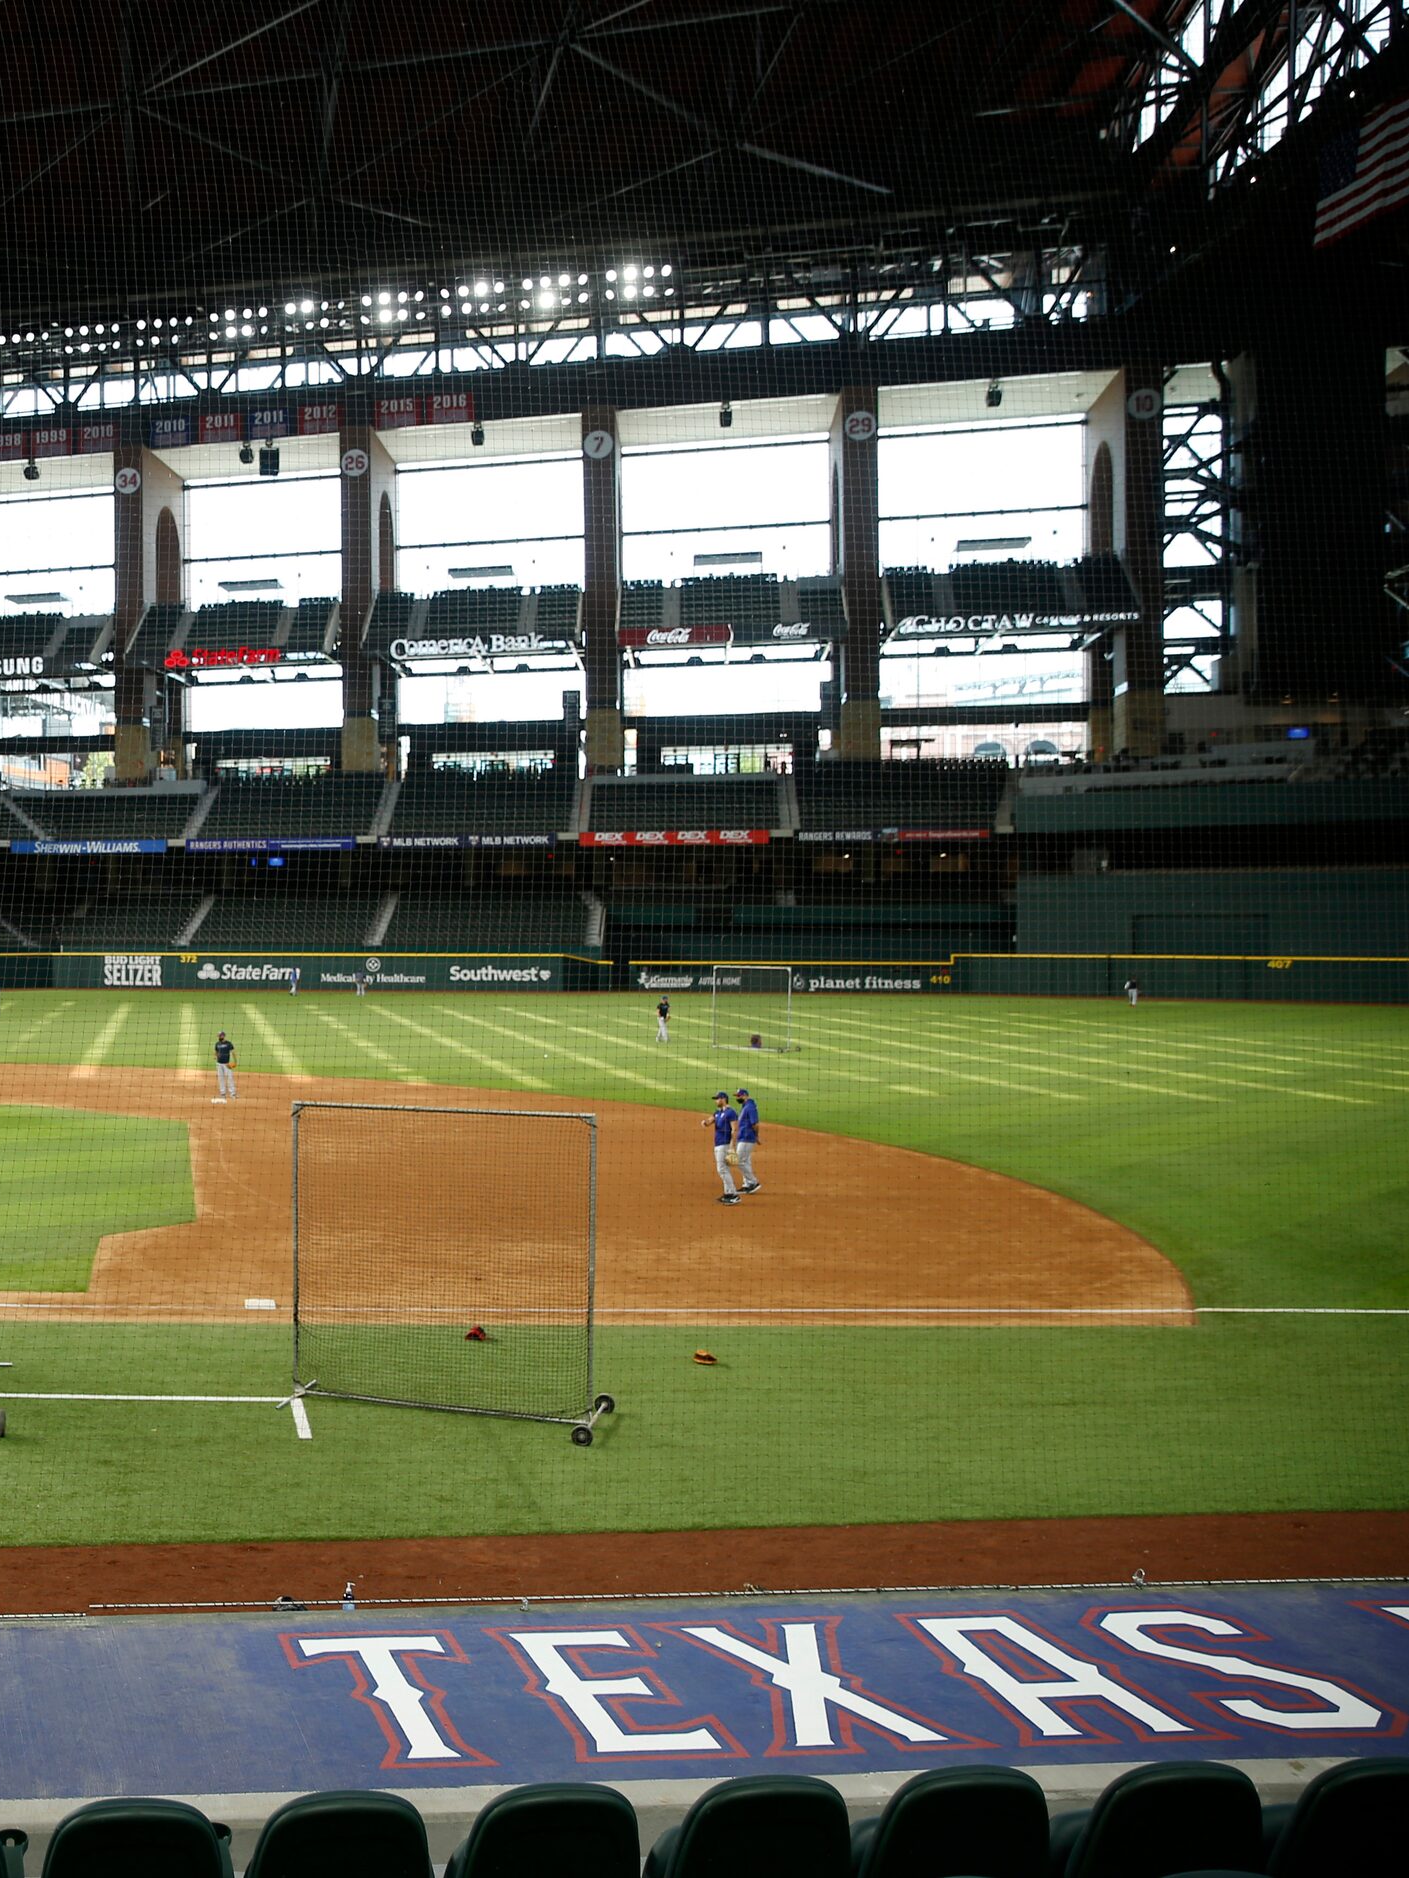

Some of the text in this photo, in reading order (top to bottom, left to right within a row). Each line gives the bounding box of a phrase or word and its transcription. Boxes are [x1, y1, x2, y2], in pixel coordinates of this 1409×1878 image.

[380, 398, 413, 413] 2015
[433, 394, 467, 409] 2016
[254, 409, 284, 425] 2011
[304, 404, 336, 420] 2012
[155, 418, 185, 432] 2010
[205, 414, 234, 429] 2011
[848, 416, 872, 434] 29
[35, 429, 67, 444] 1999
[84, 424, 114, 440] 2010
[593, 436, 605, 454] 7
[344, 455, 366, 471] 26
[118, 472, 139, 490] 34
[772, 623, 811, 637] Coca-Cola
[912, 613, 1034, 633] CHOCTAW
[1093, 612, 1139, 622] RESORTS
[490, 632, 543, 653] Bank
[647, 627, 692, 644] Coca-Cola
[392, 836, 459, 846] MLB NETWORK
[482, 834, 549, 845] MLB NETWORK
[594, 832, 625, 841] DEX
[636, 832, 666, 840] DEX
[677, 831, 707, 840] DEX
[719, 830, 751, 839] DEX
[798, 832, 833, 841] RANGERS
[835, 831, 872, 841] REWARDS
[189, 841, 221, 850] RANGERS
[223, 840, 267, 849] AUTHENTICS
[105, 956, 161, 965] BUD LIGHT
[180, 955, 197, 964] 372
[1267, 960, 1292, 969] 407
[104, 965, 161, 986] SELTZER
[320, 972, 356, 983] Medical
[377, 972, 426, 983] Healthcare
[449, 966, 538, 982] Southwest
[653, 974, 693, 983] Germania
[722, 977, 742, 985] HOME
[930, 975, 951, 984] 410
[809, 975, 921, 992] planet fitness
[298, 1608, 1382, 1760] TEXAS
